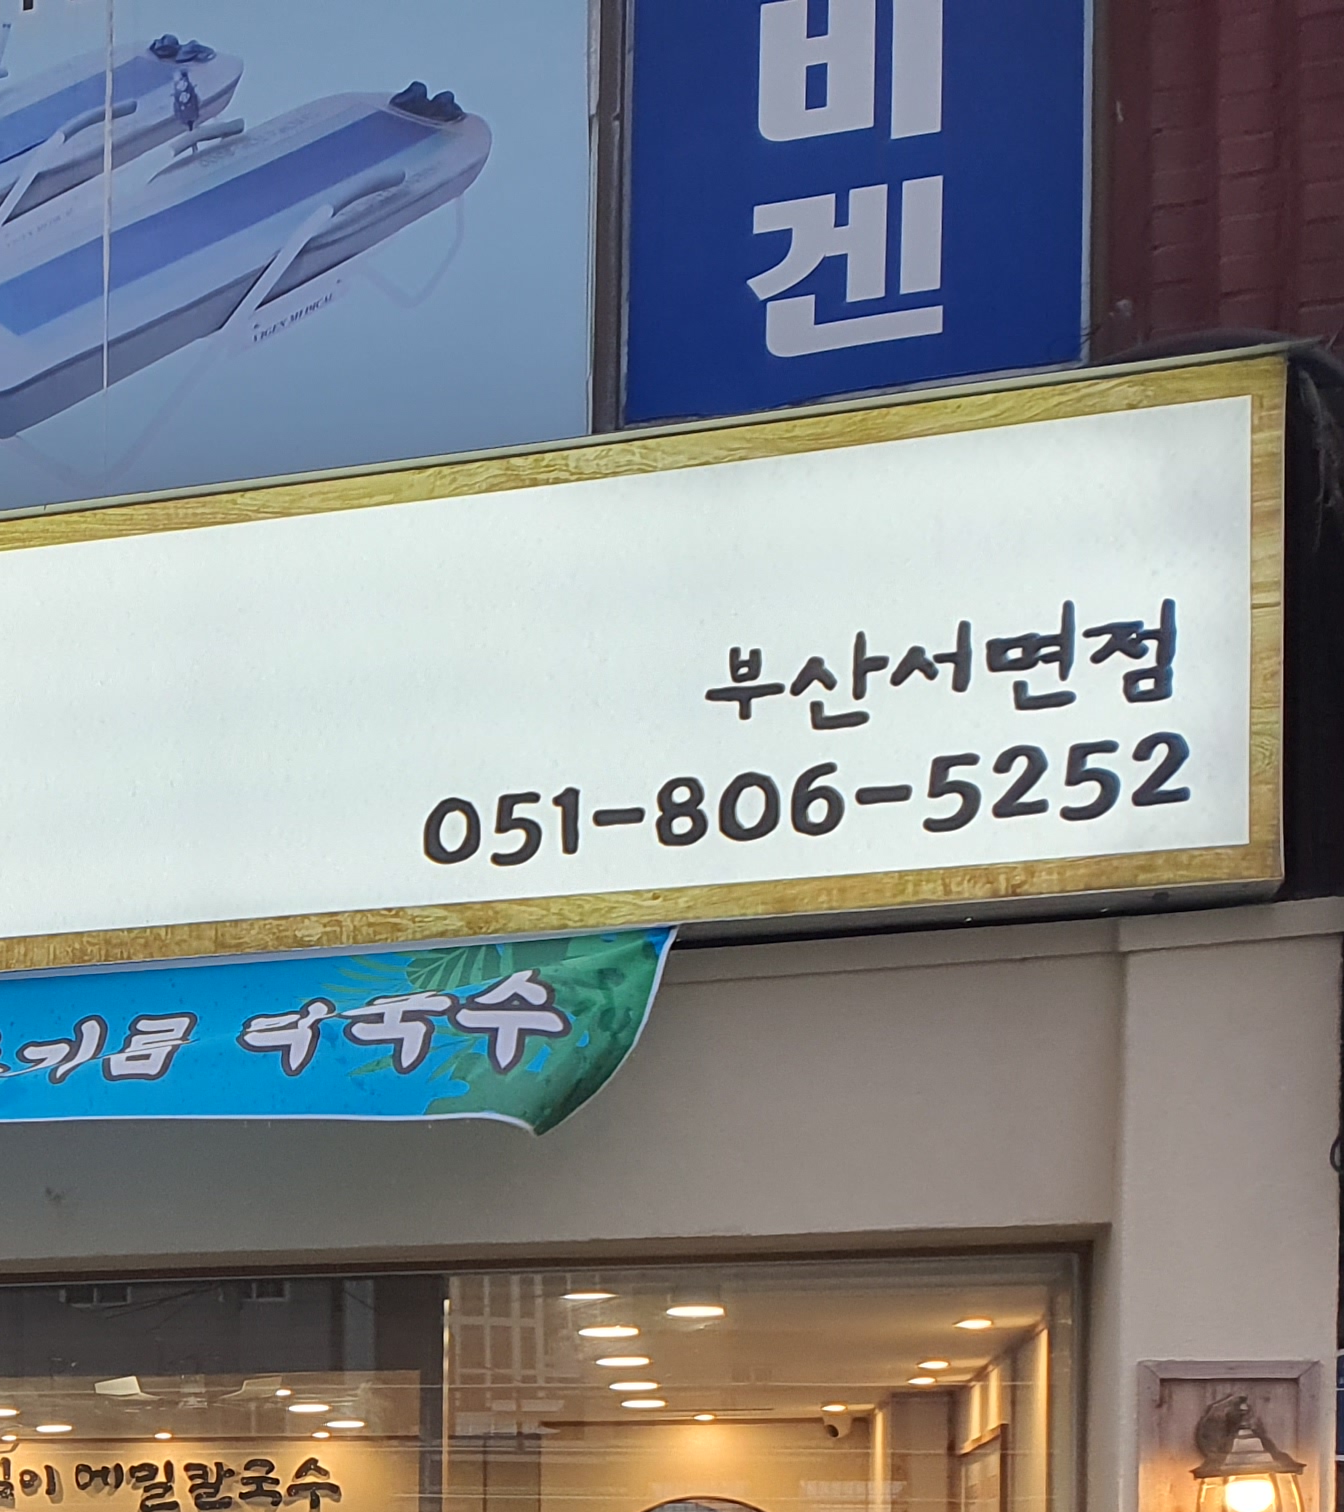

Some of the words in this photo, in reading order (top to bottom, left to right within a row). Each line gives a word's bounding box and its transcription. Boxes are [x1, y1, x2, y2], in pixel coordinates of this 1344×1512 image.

[746, 0, 944, 358] 비겐
[705, 598, 1177, 731] 부산서면점
[423, 731, 1190, 867] 051-806-5252
